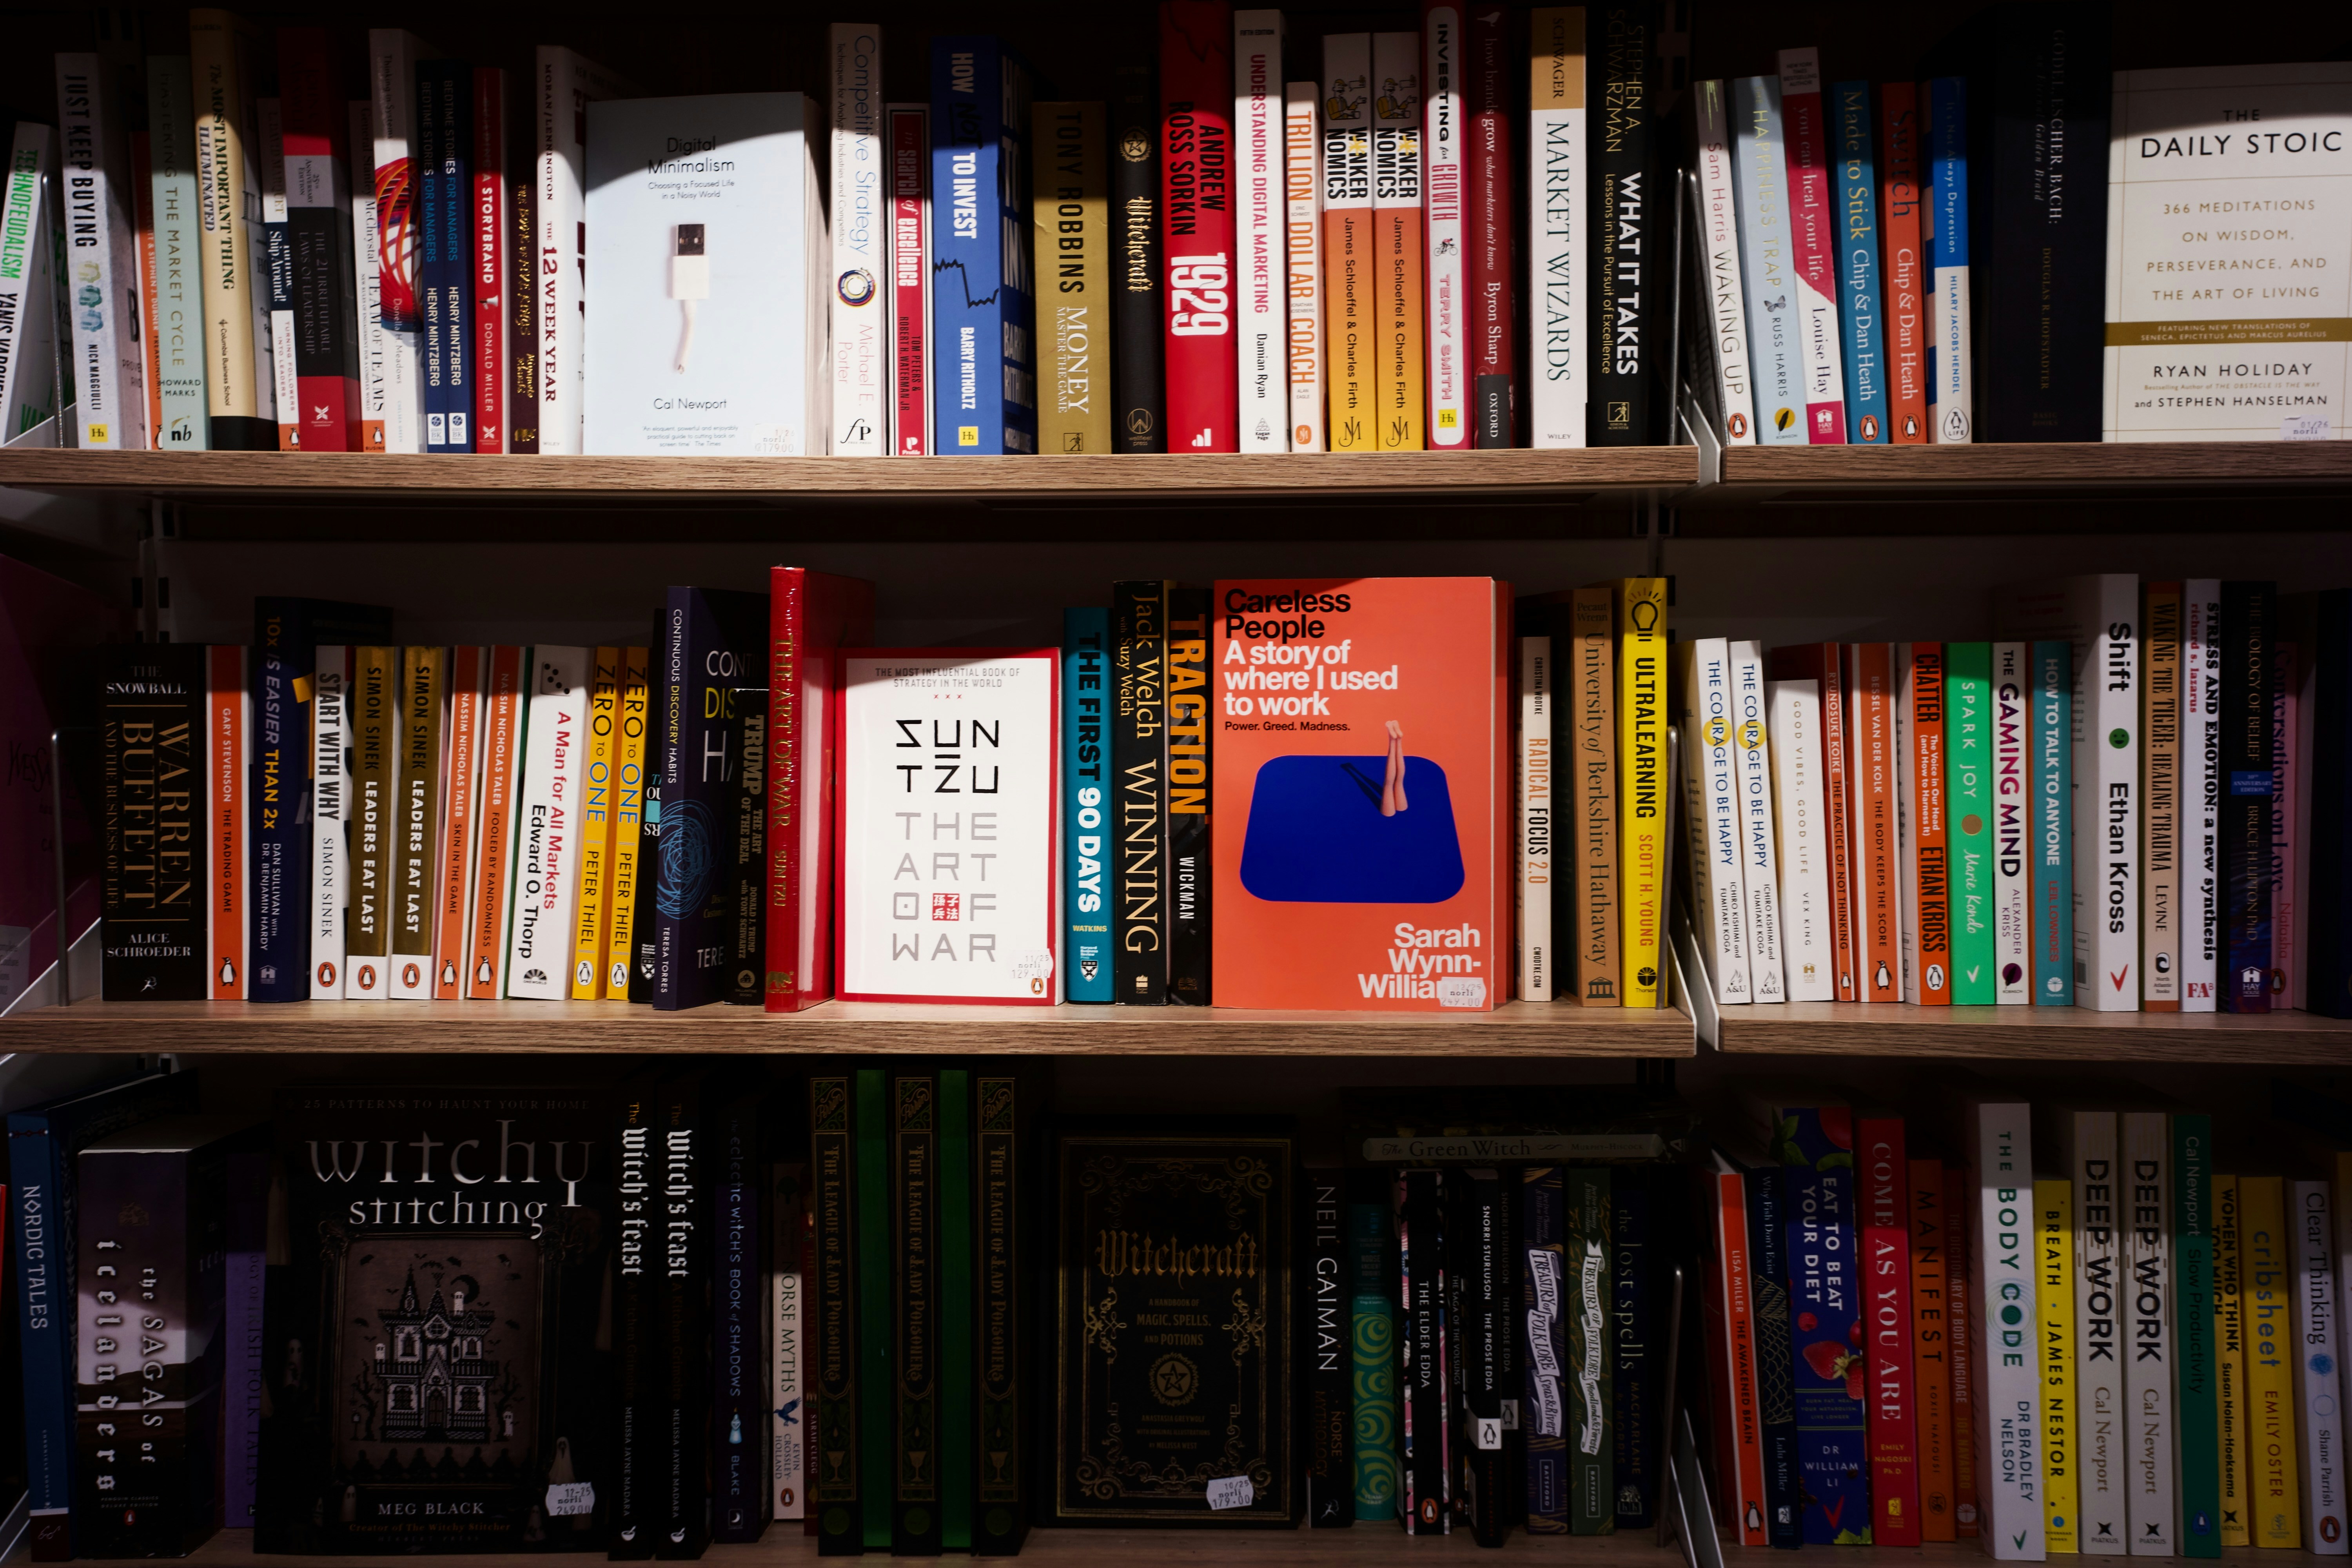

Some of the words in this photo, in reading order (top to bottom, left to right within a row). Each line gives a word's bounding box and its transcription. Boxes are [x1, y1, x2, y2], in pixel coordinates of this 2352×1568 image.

[952, 53, 974, 93] HOW
[65, 74, 90, 118] JUST
[2224, 109, 2260, 121] THE
[70, 126, 93, 170] KEEP
[667, 136, 716, 154] Digital
[955, 103, 982, 149] NOT
[1057, 111, 1084, 174] TONY
[2141, 134, 2231, 158] DAILY
[2247, 132, 2342, 154] STOIC
[649, 159, 734, 174] Minimalism
[649, 181, 682, 191] Choosing
[953, 153, 976, 174] TO
[1546, 122, 1570, 241] MARKET
[73, 178, 97, 247] BUYING
[954, 179, 976, 238] INVEST
[1604, 173, 1615, 218] Lessons
[1618, 172, 1641, 255] WHAT
[2164, 204, 2190, 214] 366
[2199, 200, 2315, 212] MEDITATIONS
[1058, 188, 1085, 293] ROBBINS
[1123, 197, 1152, 292] Witchcraft
[1604, 221, 1613, 232] in
[1604, 235, 1613, 252] the
[543, 247, 558, 275] 12
[1602, 257, 1613, 296] Pursuit
[1618, 262, 1639, 285] IT
[1895, 249, 1913, 288] Chip
[545, 280, 556, 341] WEEK
[1170, 252, 1229, 335] 1929
[1547, 251, 1570, 381] WIZARDS
[1602, 299, 1613, 310] of
[1898, 292, 1913, 310] &
[960, 327, 975, 360] BARRY
[1601, 314, 1612, 373] Excellence
[1616, 292, 1639, 374] TAKES
[1899, 314, 1914, 347] Dan
[545, 347, 557, 402] YEAR
[1067, 307, 1089, 414] MONEY
[1900, 352, 1916, 399] Heath
[2154, 365, 2206, 377] RYAN
[2220, 363, 2313, 376] HOLIDAY
[654, 399, 674, 410] Cal
[678, 398, 726, 411] Newport
[962, 363, 976, 409] RITHOLTZ
[1490, 393, 1498, 437] OXFORD
[1225, 589, 1350, 613] Careless
[266, 616, 281, 646] 10x
[1226, 615, 1325, 644] People
[266, 654, 280, 670] IS
[1078, 633, 1101, 690] THE
[1224, 641, 1246, 665] A
[1250, 642, 1319, 670] story
[1323, 639, 1350, 664] of
[2109, 622, 2131, 691] Shift
[318, 674, 339, 726] START
[1224, 666, 1310, 690] where
[1317, 666, 1323, 689] I
[1330, 665, 1398, 690] used
[265, 675, 279, 744] EASIER
[557, 712, 571, 724] A
[1170, 613, 1206, 813] TRACTION
[1224, 691, 1253, 715] to
[1258, 691, 1329, 715] work
[1961, 682, 1976, 749] SPARK
[1078, 699, 1101, 781] FIRST
[1263, 722, 1297, 730] Greed.
[1300, 722, 1350, 730] Madness.
[1635, 657, 1656, 818] ULTRALEARNING
[223, 740, 231, 802] STEVENSON
[319, 733, 339, 775] WITH
[555, 731, 570, 769] Man
[264, 750, 279, 802] THAN
[552, 776, 566, 802] for
[1960, 764, 1976, 797] JOY
[122, 719, 155, 908] BUFFETT
[158, 719, 191, 907] WARREN
[263, 809, 279, 829] 2x
[319, 782, 340, 820] WHY
[550, 807, 564, 829] All
[1078, 788, 1101, 829] 90
[2110, 783, 2128, 854] Ethan
[223, 832, 231, 878] TRADING
[526, 804, 546, 873] Edward
[1125, 759, 1158, 954] WINNING
[525, 880, 541, 898] O.
[543, 836, 563, 909] Markets
[1077, 836, 1101, 912] DAYS
[1179, 857, 1195, 919] WICKMAN
[1921, 847, 1943, 896] ETHAN
[223, 883, 231, 913] GAME
[2110, 862, 2128, 933] Kross
[519, 906, 539, 959] Thorp
[1395, 923, 1480, 948] Sarah
[1922, 901, 1945, 952] KROSS
[1441, 997, 1480, 1007] 249.00
[671, 1103, 682, 1125] The
[305, 1119, 595, 1208] witchy
[1382, 1143, 1403, 1155] The
[1409, 1140, 1467, 1156] Green
[1472, 1139, 1530, 1155] Witch
[664, 1130, 694, 1214] Witch's
[1872, 1142, 1893, 1226] COME
[22, 1185, 44, 1259] NORDIC
[349, 1191, 548, 1240] stitching
[1317, 1186, 1336, 1246] NEIL
[2135, 1161, 2158, 1245] DEEP
[2306, 1192, 2325, 1245] Clear
[666, 1220, 694, 1278] feast
[1732, 1250, 1742, 1274] LISA
[1875, 1238, 1896, 1275] AS
[26, 1264, 48, 1329] TALES
[780, 1261, 796, 1321] NORSE
[1317, 1257, 1337, 1370] GAIMAN
[1419, 1281, 1430, 1307] THE
[1733, 1278, 1744, 1312] MILLER
[2136, 1257, 2161, 1362] WORK
[2307, 1252, 2330, 1344] Thinking
[1419, 1311, 1430, 1349] ELDER
[1737, 1320, 1748, 1340] THE
[1878, 1287, 1898, 1348] YOU
[781, 1328, 797, 1392] MYTHS
[1419, 1355, 1431, 1388] EDDA
[1738, 1343, 1751, 1406] AWAKENED
[1880, 1359, 1901, 1420] ARE
[2018, 1401, 2031, 1423] DR
[2144, 1388, 2159, 1416] Cal
[1742, 1410, 1753, 1444] BRAIN
[2002, 1418, 2015, 1482] NELSON
[2019, 1428, 2033, 1501] BRADLEY
[2141, 1421, 2159, 1494] Newport
[1212, 1495, 1250, 1508] 179.00
[1218, 1488, 1241, 1498] norli
[1224, 1479, 1249, 1490] 10/25
[378, 1503, 416, 1515] MEG
[425, 1502, 485, 1515] BLACK
